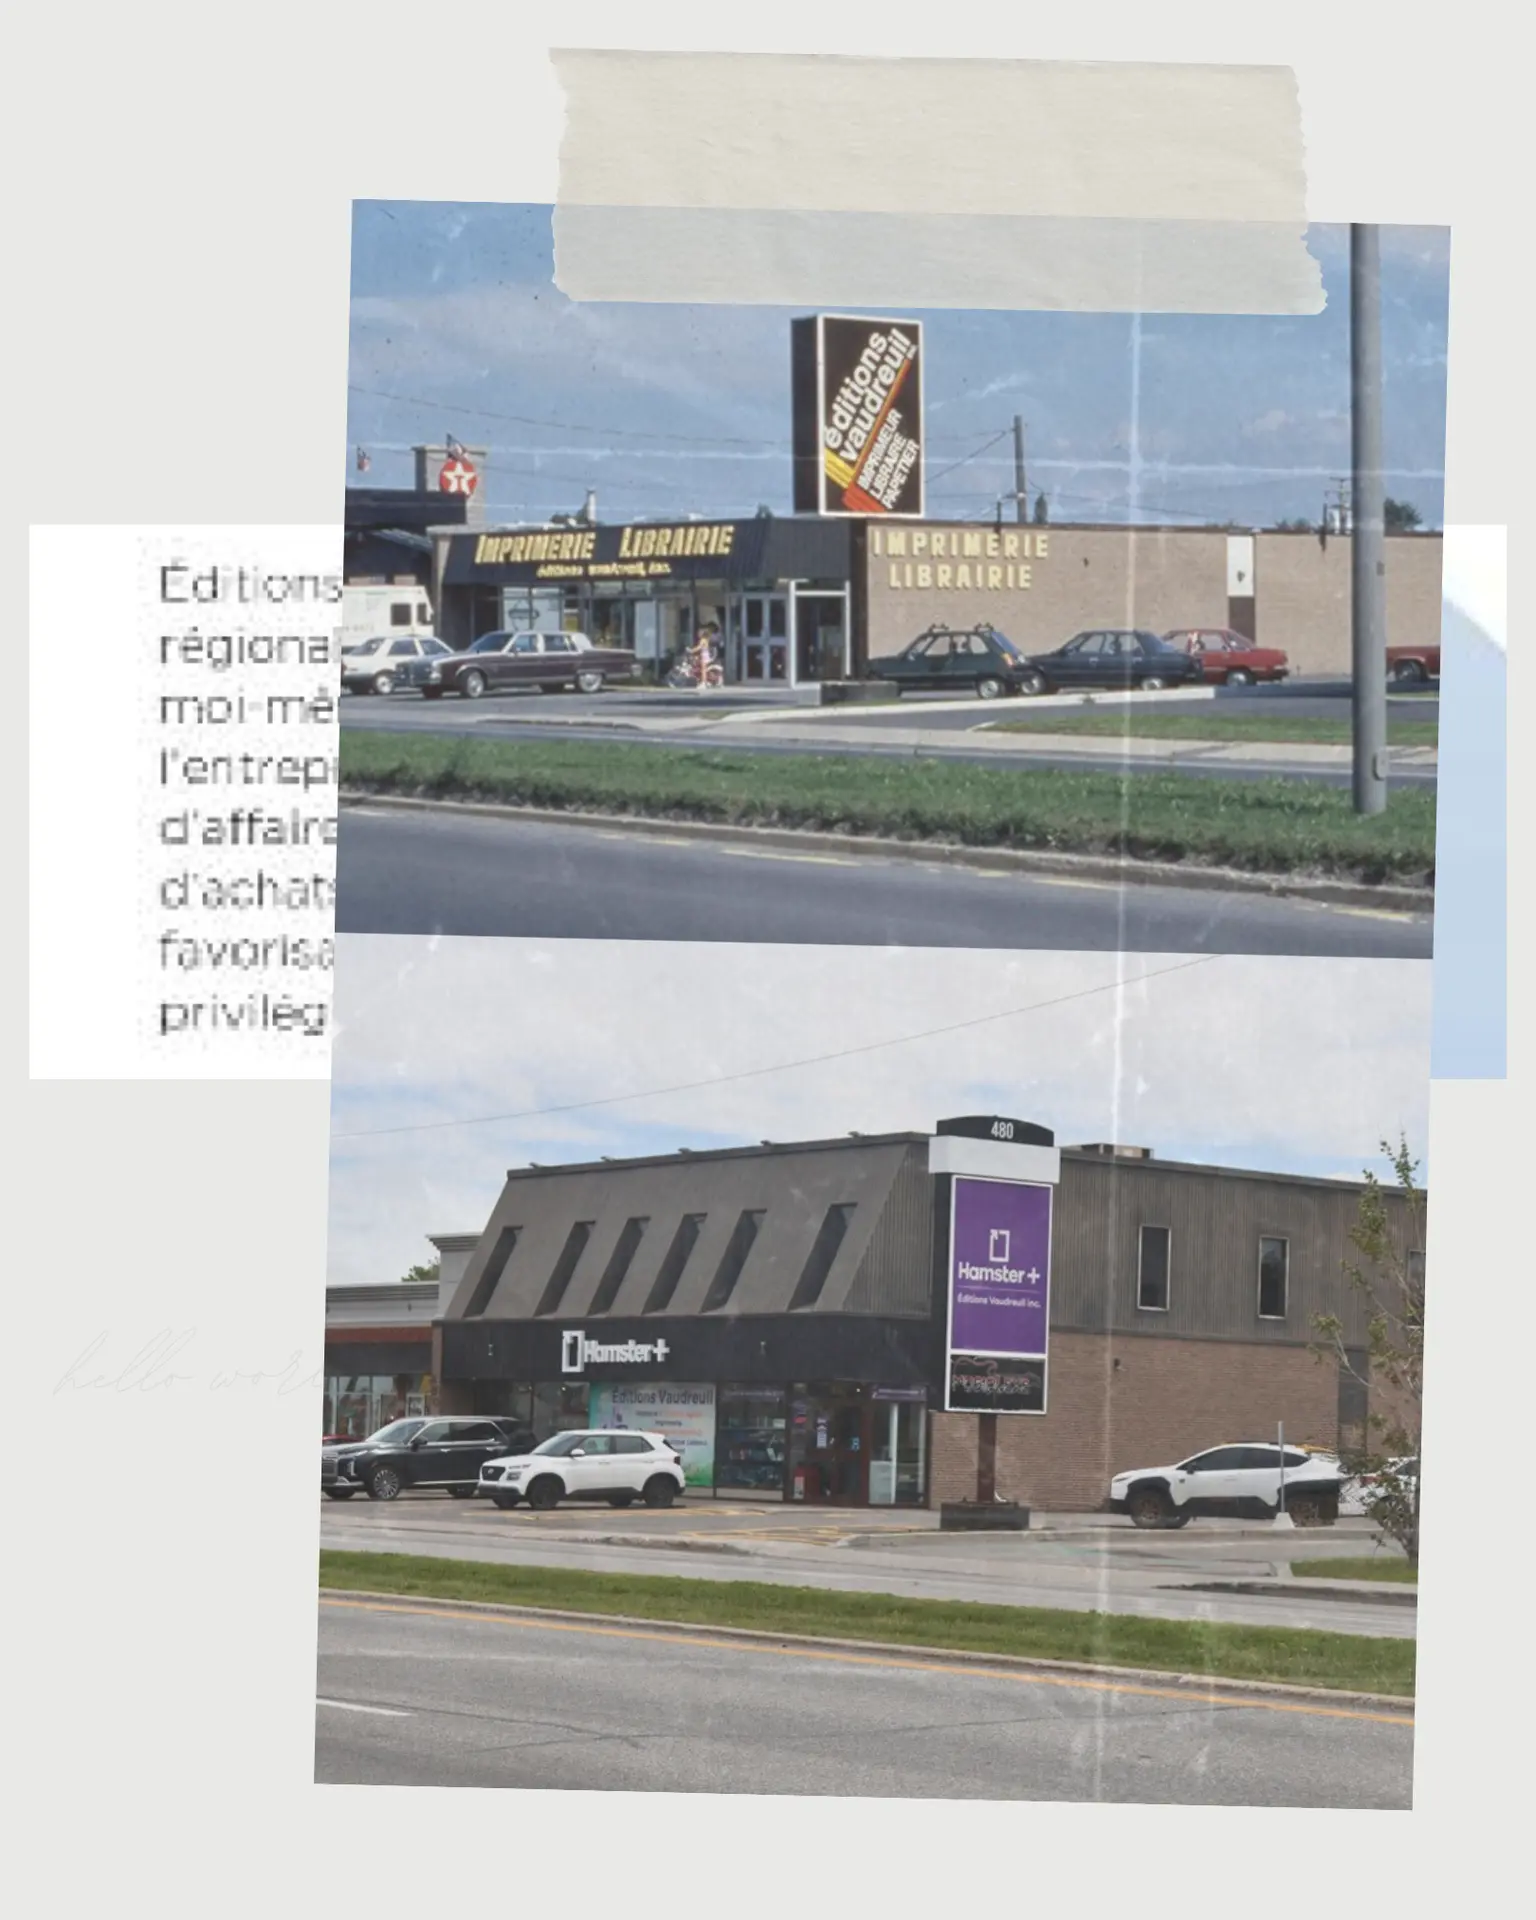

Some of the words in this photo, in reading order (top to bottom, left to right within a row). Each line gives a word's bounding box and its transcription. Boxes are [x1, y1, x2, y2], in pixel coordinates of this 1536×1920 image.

[825, 332, 887, 448] éditions
[839, 327, 911, 461] vaudreuil
[857, 408, 902, 490] IMPRIMEUR
[869, 431, 907, 500] LIBRAIRE
[880, 438, 920, 510] PAPETIER
[872, 530, 1048, 559] IMPRIMERIE
[889, 564, 1032, 590] LIBRAIRIE
[991, 1121, 1014, 1139] 480
[612, 1386, 656, 1404] Éditions
[658, 1389, 713, 1405] Vaudreuil
